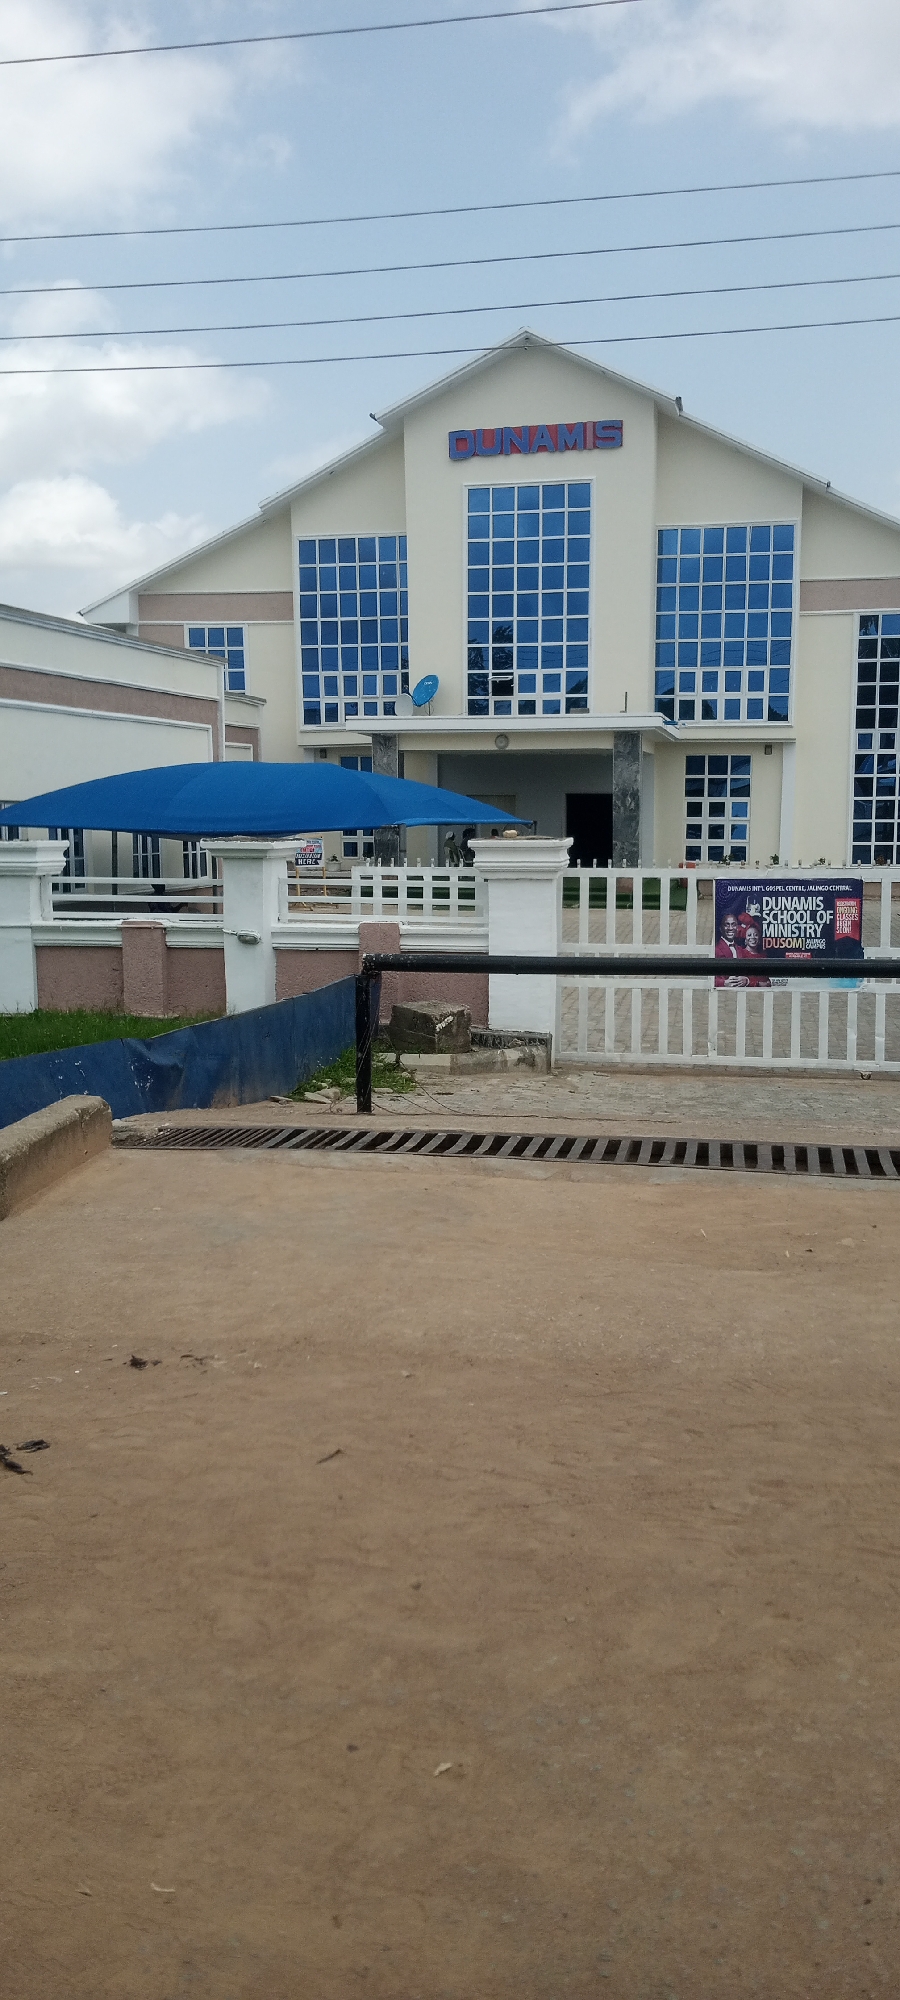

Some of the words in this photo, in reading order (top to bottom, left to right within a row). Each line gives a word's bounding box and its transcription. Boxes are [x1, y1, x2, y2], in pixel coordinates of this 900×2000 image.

[448, 420, 623, 461] DUNAMIS
[762, 896, 824, 911] DUNAMIS
[762, 910, 814, 924] SCHOOL
[816, 910, 834, 924] OF
[762, 923, 823, 938] MINISTRY
[762, 937, 805, 950] [DUSOM]
